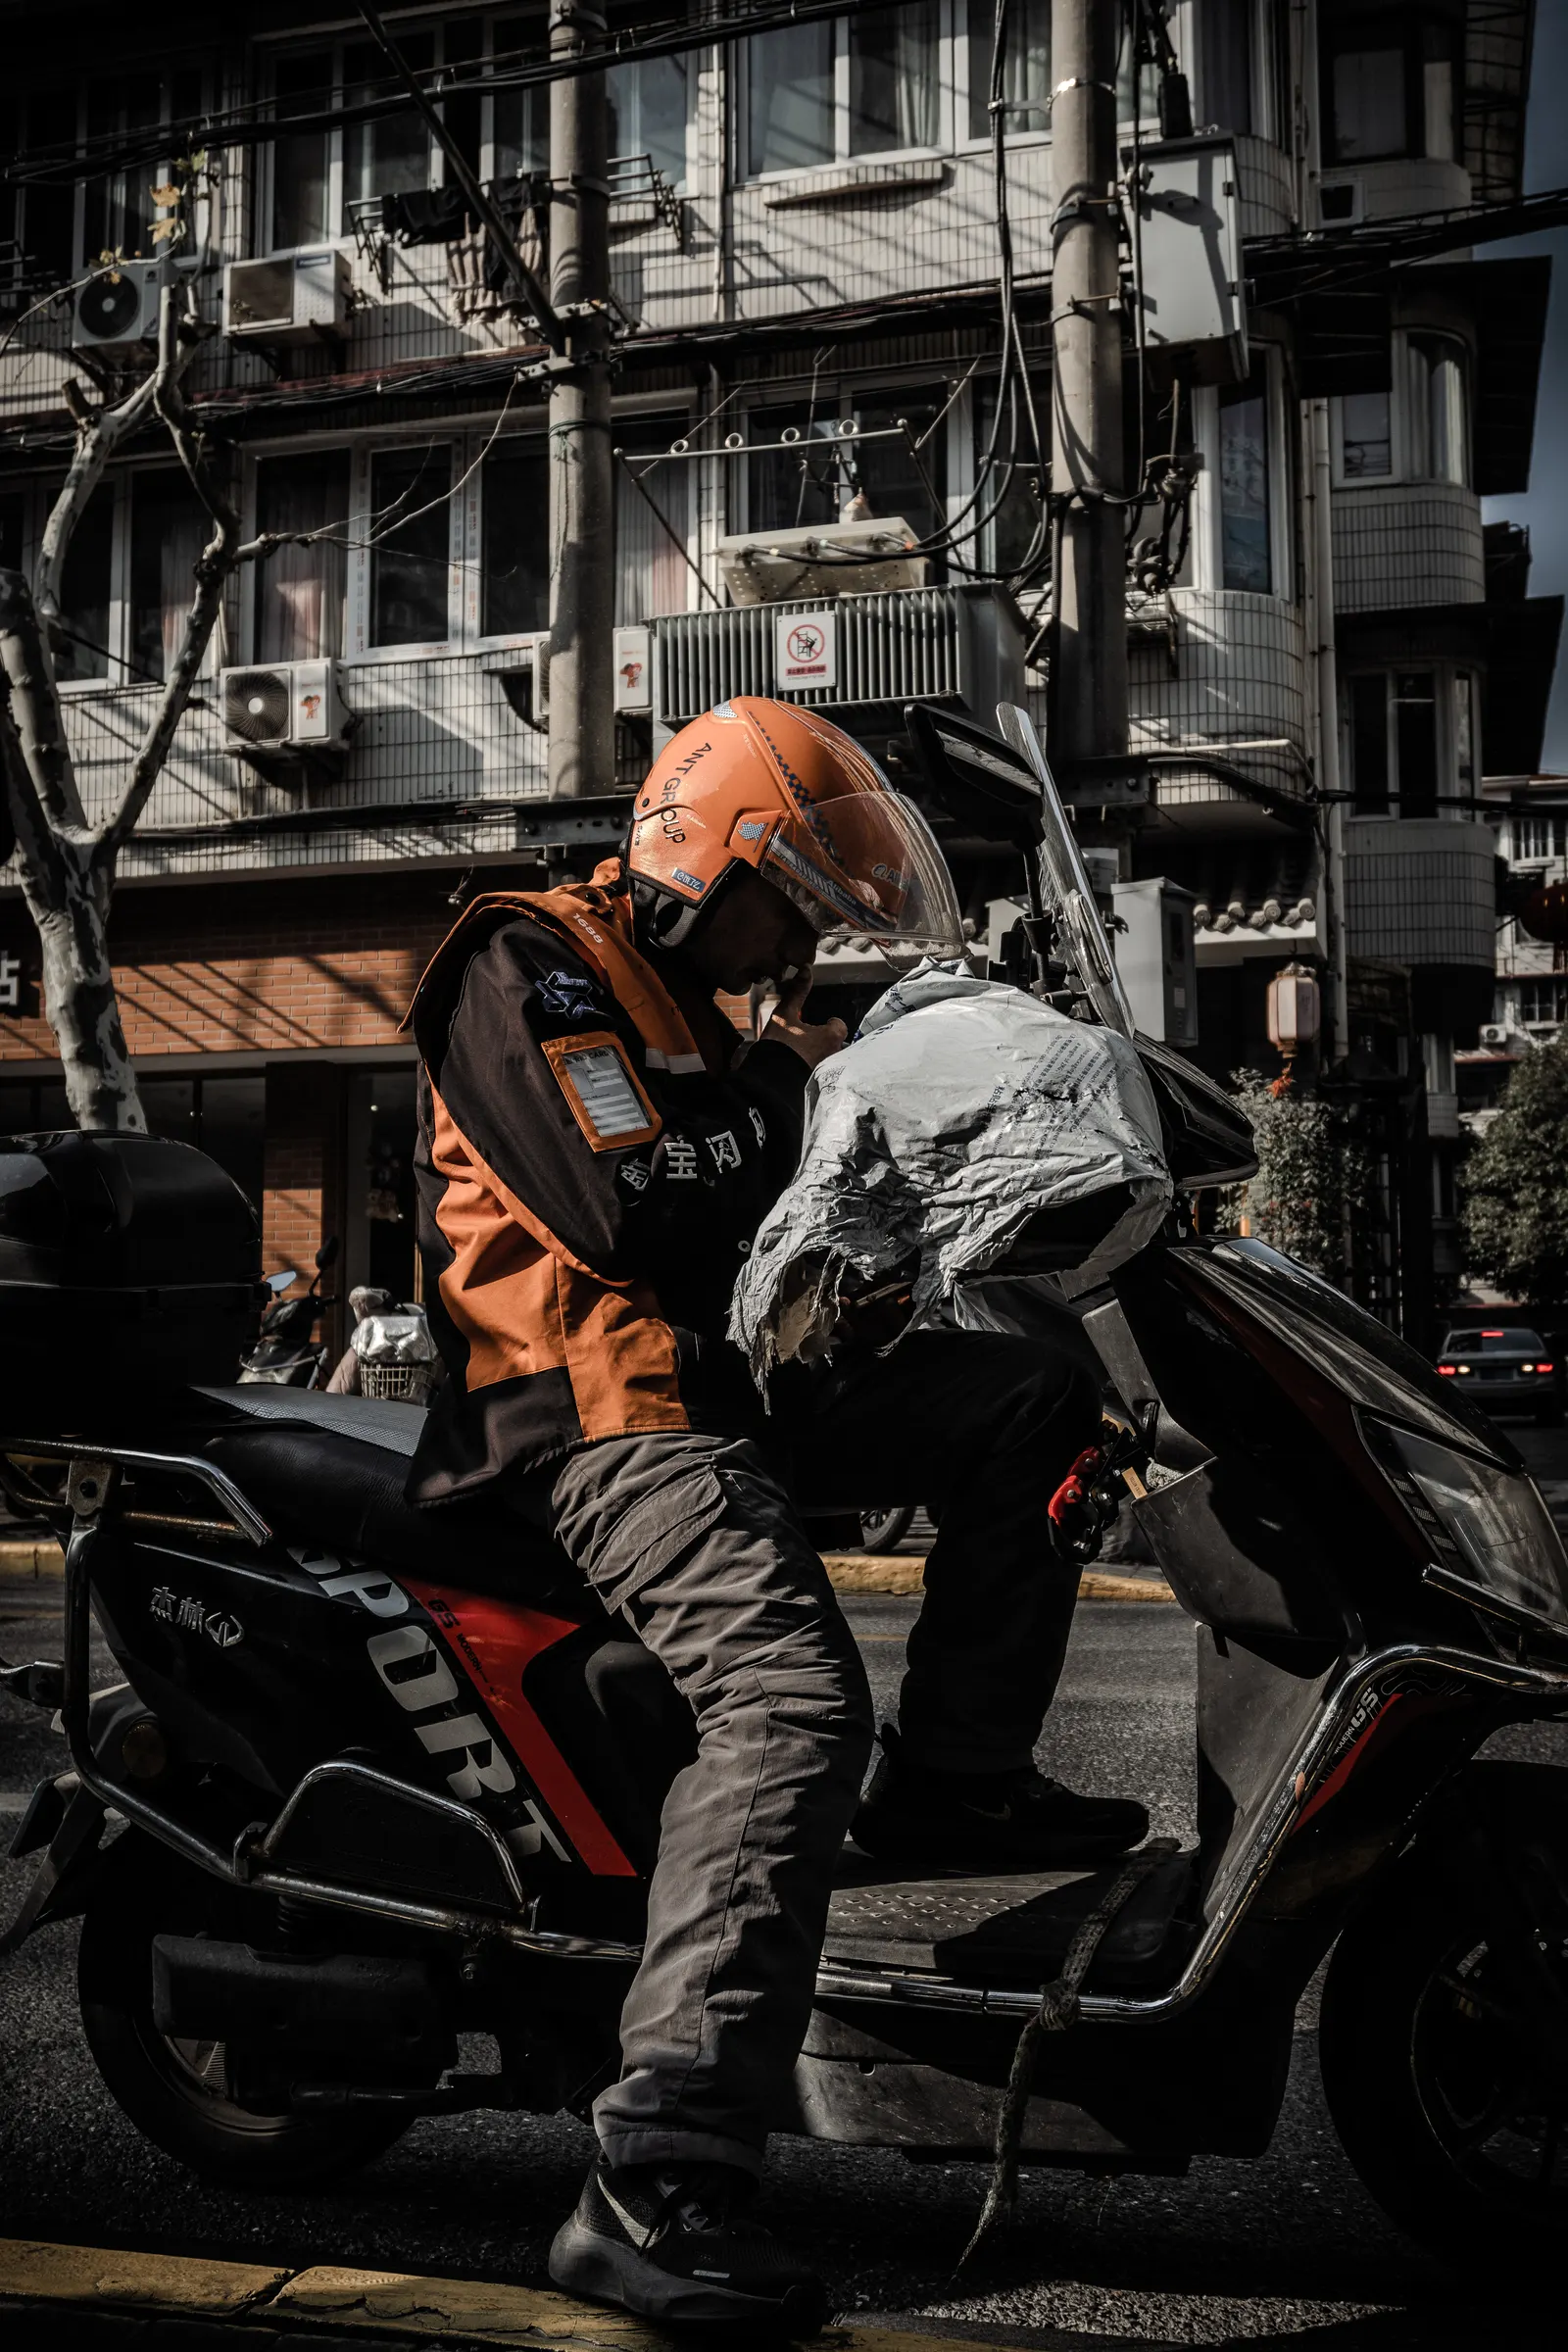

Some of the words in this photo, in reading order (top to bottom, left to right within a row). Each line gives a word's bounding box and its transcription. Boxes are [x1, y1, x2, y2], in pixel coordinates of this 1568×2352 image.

[675, 742, 712, 775] ANT
[660, 777, 686, 844] GROUP
[572, 912, 604, 944] 1688
[428, 1599, 461, 1628] GS
[456, 1633, 483, 1671] MODERN
[1350, 1687, 1379, 1728] GS
